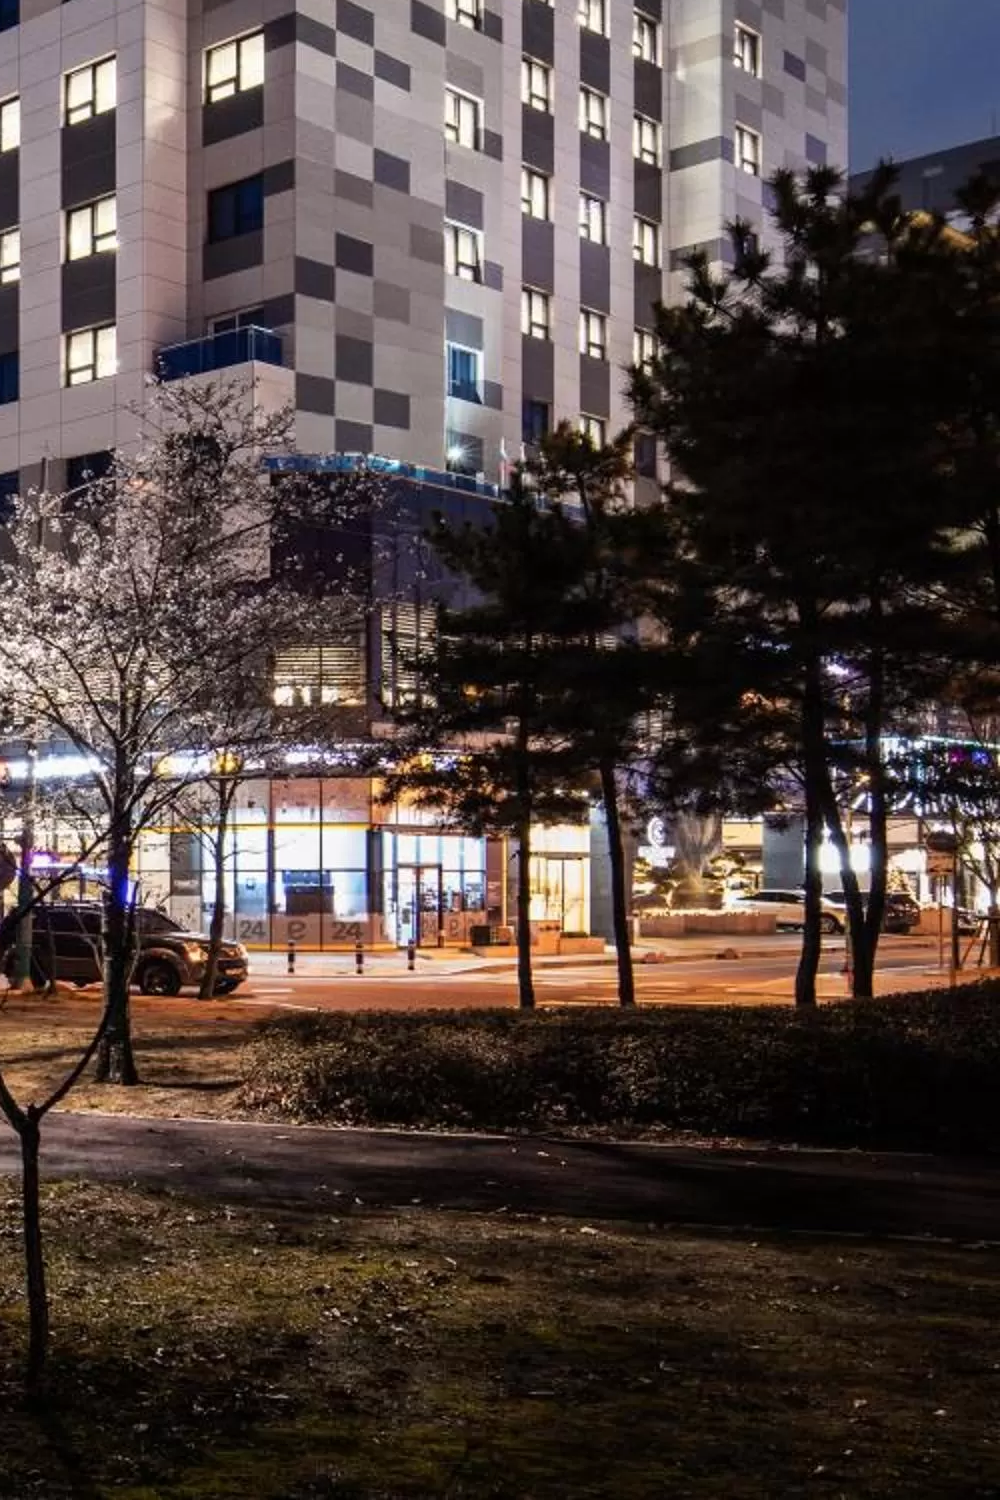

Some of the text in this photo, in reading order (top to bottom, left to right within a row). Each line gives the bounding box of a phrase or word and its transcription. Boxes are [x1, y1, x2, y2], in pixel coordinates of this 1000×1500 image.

[239, 920, 363, 940] 24 e 24
